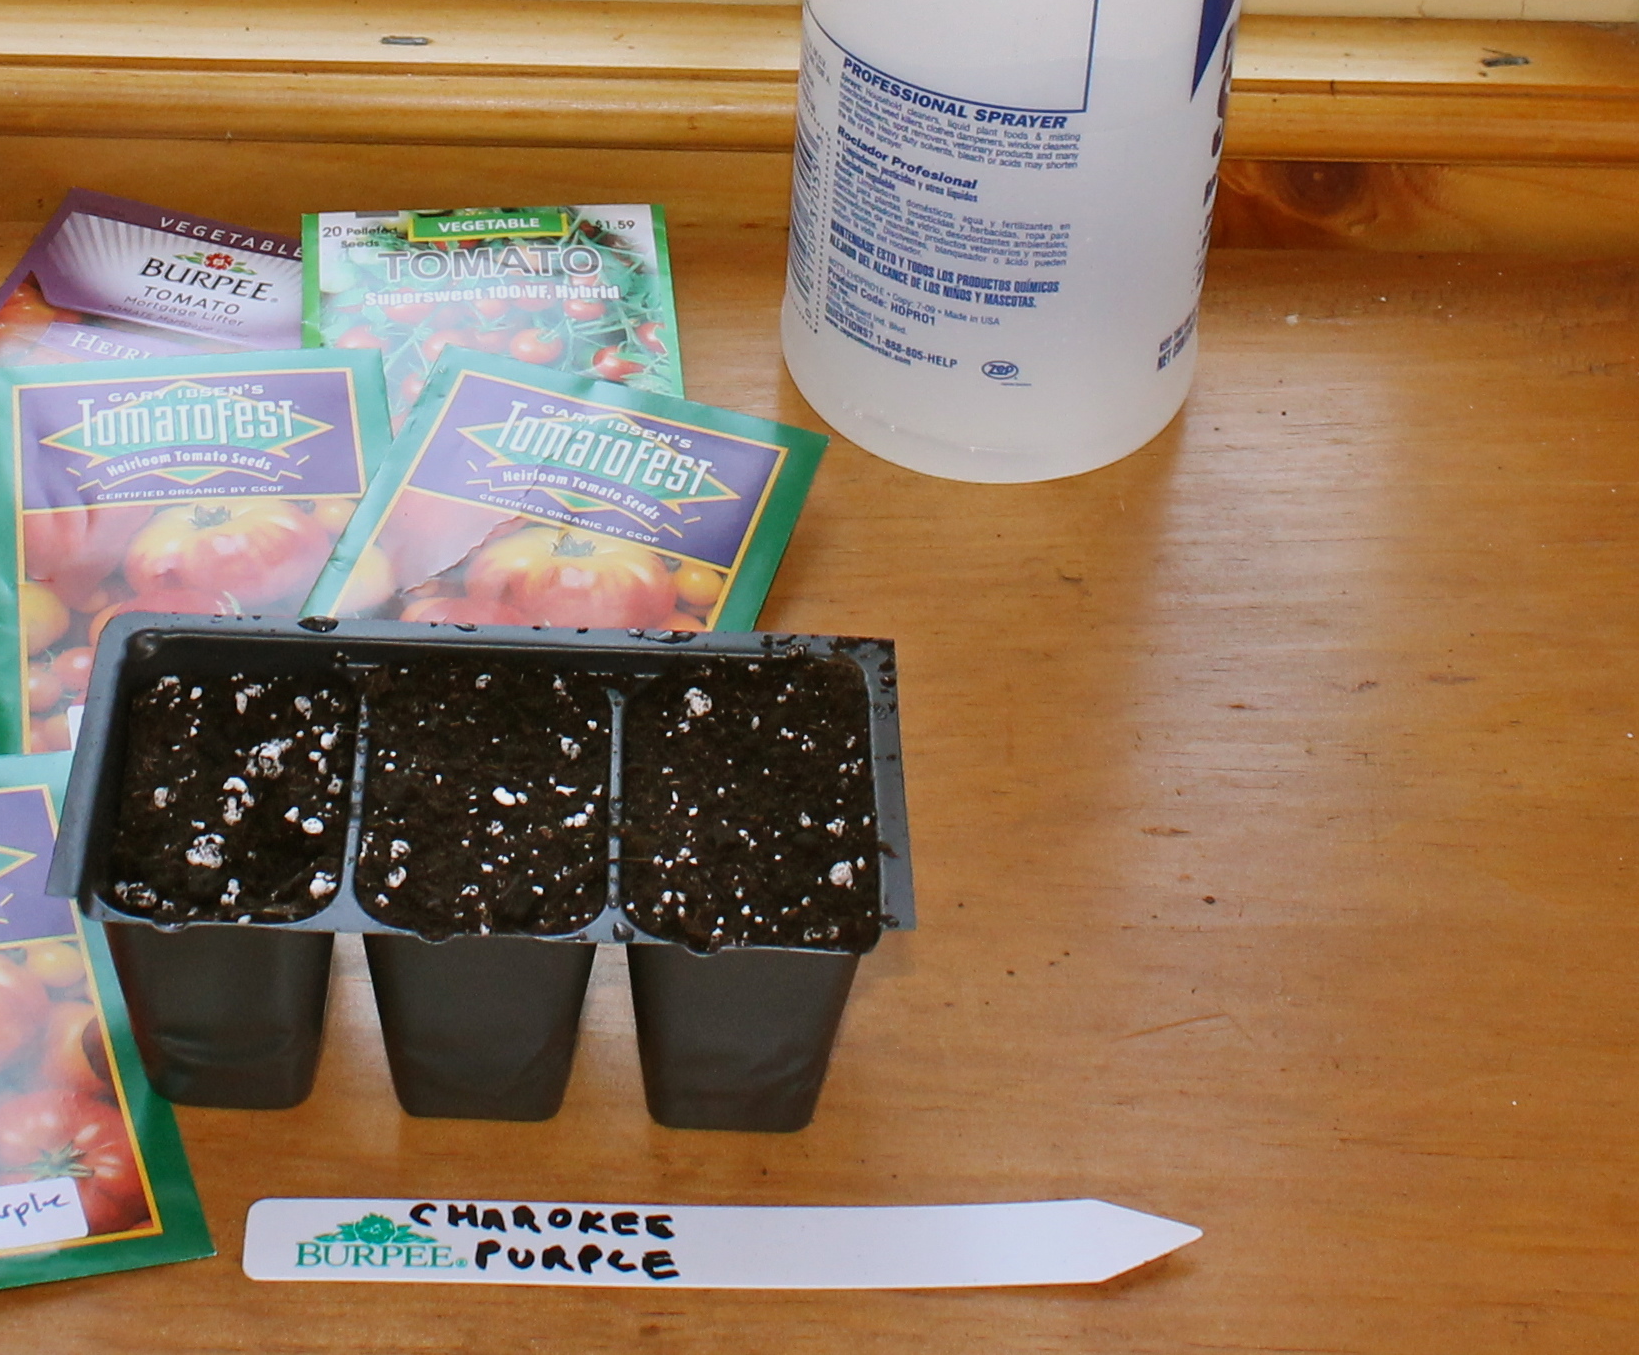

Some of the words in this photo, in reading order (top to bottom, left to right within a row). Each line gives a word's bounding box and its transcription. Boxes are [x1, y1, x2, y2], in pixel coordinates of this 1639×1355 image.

[843, 56, 968, 119] PROFESSIONAL
[974, 109, 1068, 129] SPRAYER
[891, 155, 978, 190] Profesional
[322, 226, 342, 238] 20
[437, 217, 540, 233] VEGETABLE
[595, 219, 635, 231] $1.59
[340, 239, 380, 249] Seeds
[377, 246, 602, 282] TOMATO
[143, 286, 241, 315] TOMATO
[364, 287, 483, 307] Supersweet
[486, 285, 522, 301] 100
[560, 284, 620, 300] Hybrid
[124, 295, 197, 320] Mortgage
[200, 310, 243, 328] Lifter
[108, 391, 168, 403] GARY
[540, 404, 601, 425] GARY
[607, 420, 693, 449] IBSEN'S
[107, 452, 171, 477] Heirloom
[175, 451, 228, 464] Tomato
[232, 452, 272, 471] Seeds
[97, 489, 165, 501] CERTIFIED
[168, 487, 225, 496] ORGANIC
[250, 484, 284, 493] CCOF
[503, 469, 569, 486] Heirloom
[572, 476, 622, 503] Tomato
[622, 495, 661, 521] Seeds
[479, 493, 545, 516] CERTIFIED
[546, 509, 603, 530] ORGANIC
[606, 525, 623, 535] BY
[626, 531, 661, 544] CCOF
